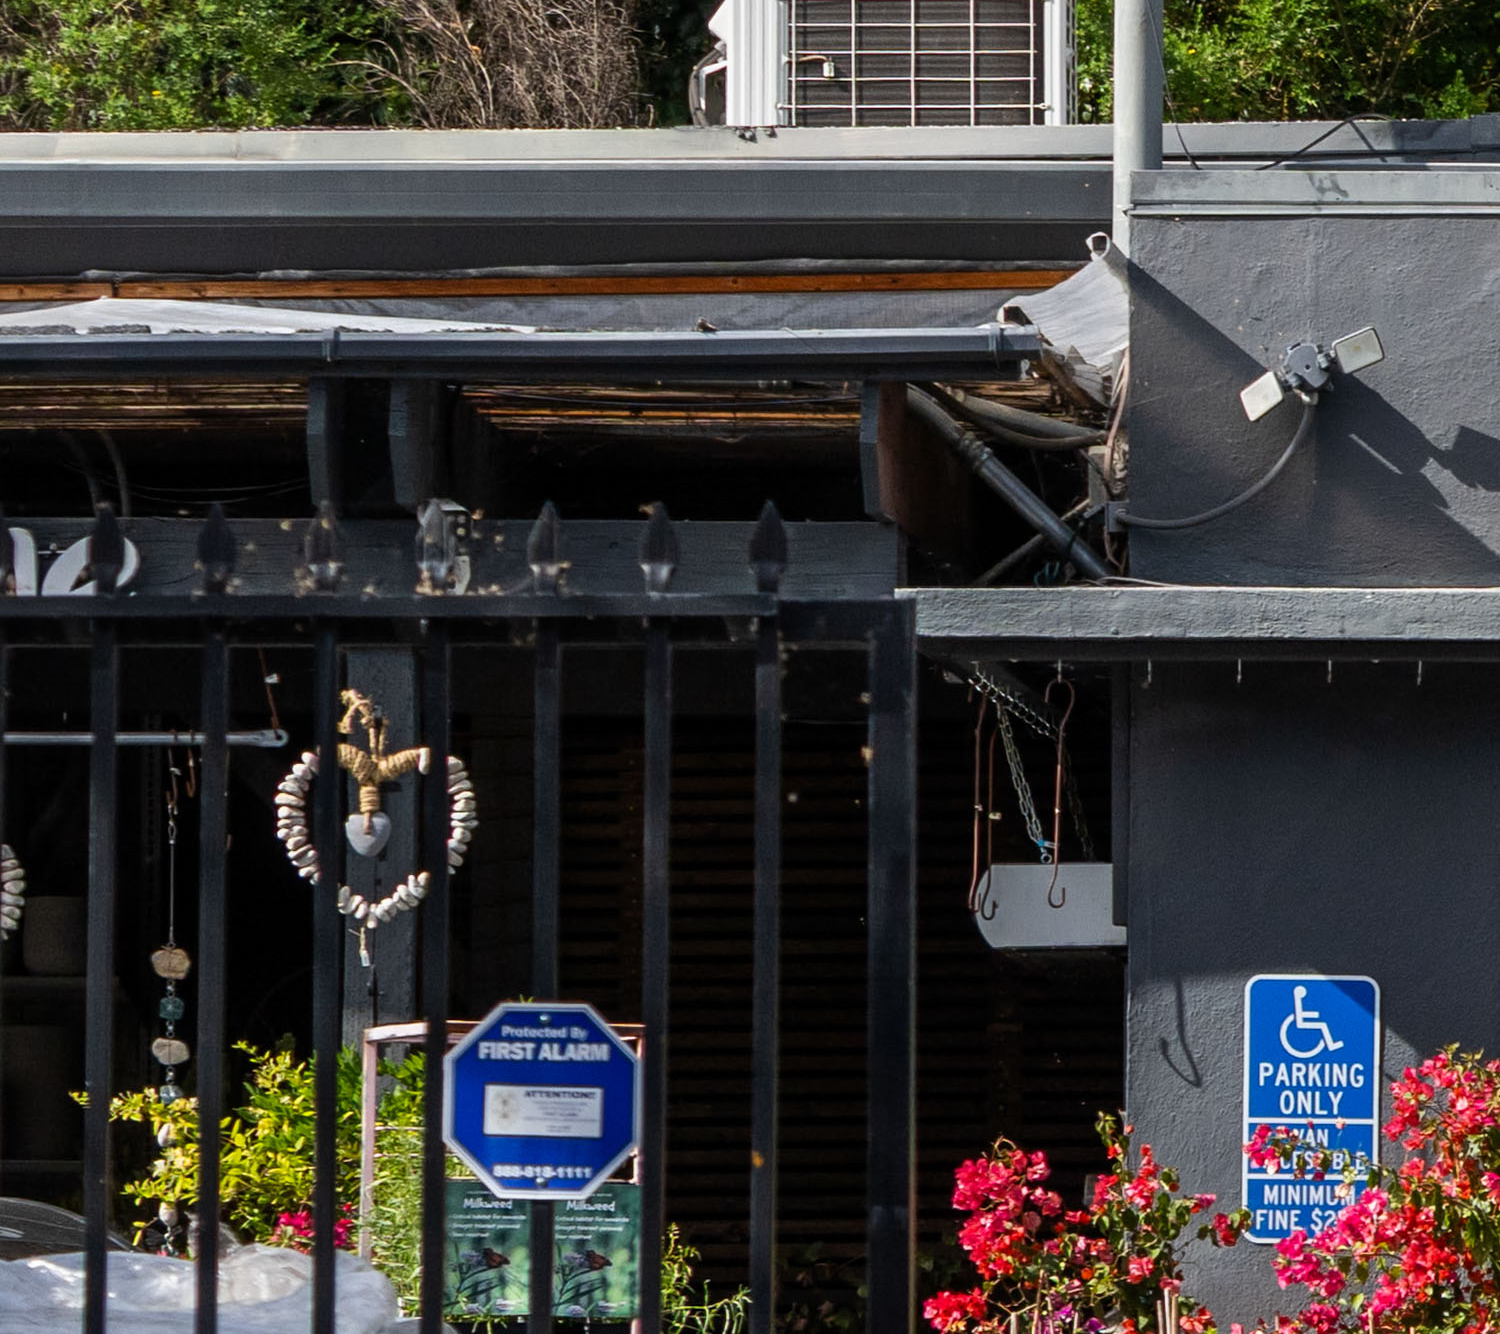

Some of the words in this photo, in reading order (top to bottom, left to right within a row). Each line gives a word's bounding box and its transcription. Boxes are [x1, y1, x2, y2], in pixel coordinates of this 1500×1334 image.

[501, 1026, 567, 1038] Protected
[570, 1027, 588, 1040] By
[478, 1041, 536, 1061] FIRST
[538, 1042, 611, 1061] ALARM
[1258, 1062, 1365, 1089] PARKING
[1279, 1090, 1344, 1116] ONLY
[463, 1198, 513, 1210] Milkweed
[566, 1199, 616, 1212] Milkweed
[1263, 1184, 1357, 1207] MINIMUM
[1255, 1209, 1302, 1232] FINE
